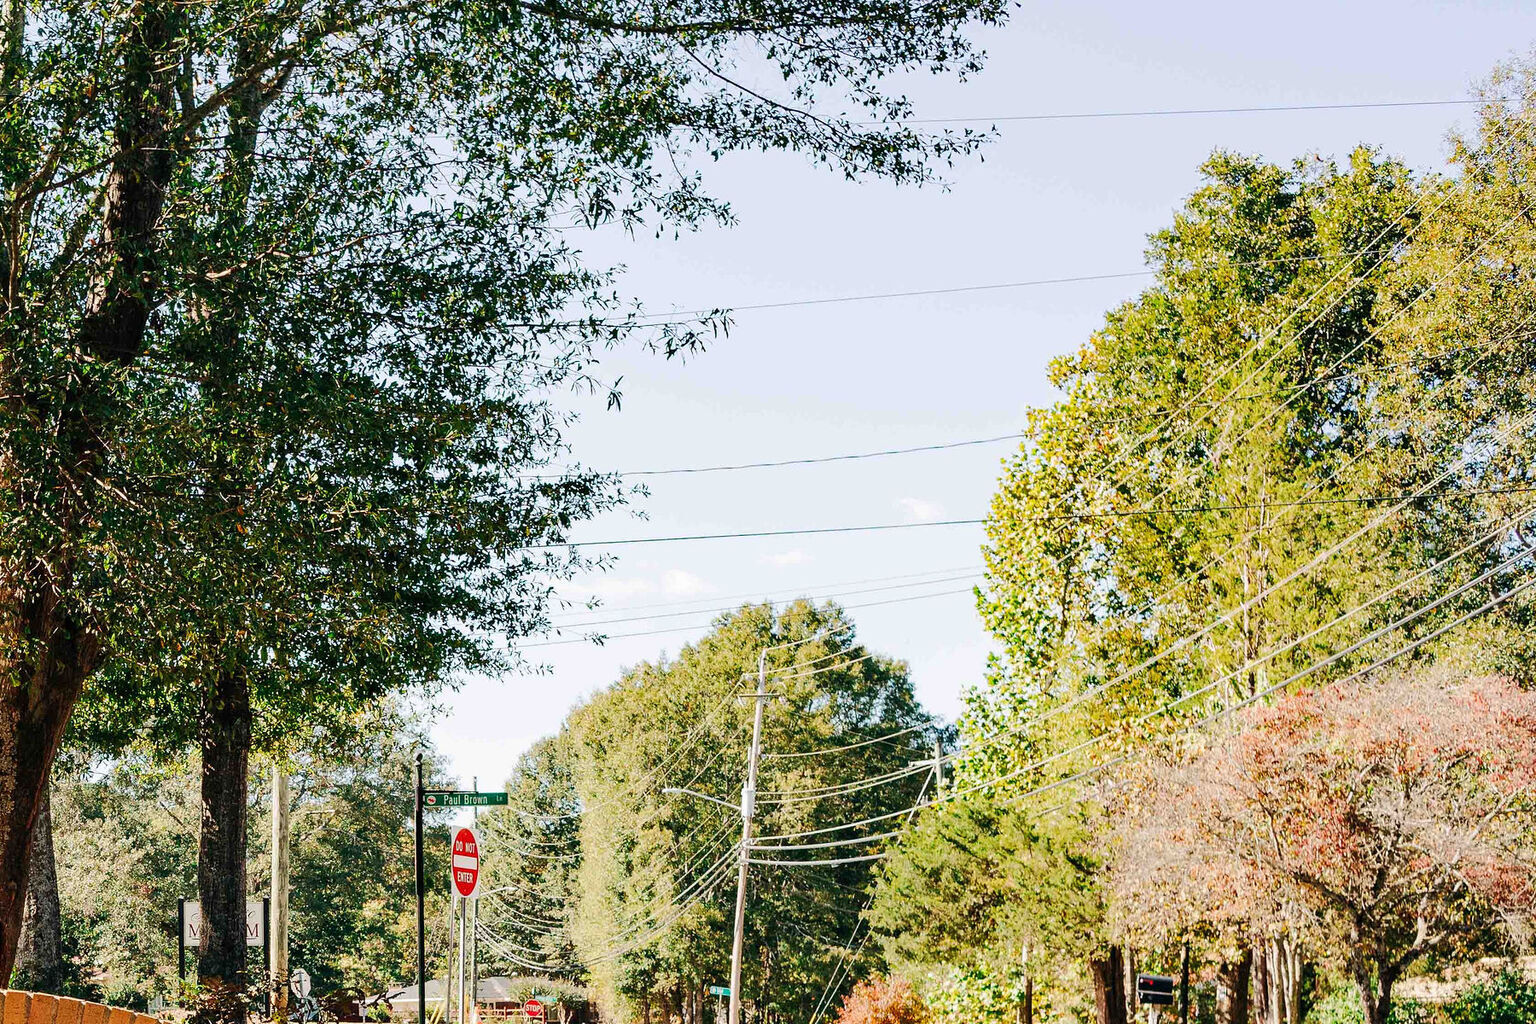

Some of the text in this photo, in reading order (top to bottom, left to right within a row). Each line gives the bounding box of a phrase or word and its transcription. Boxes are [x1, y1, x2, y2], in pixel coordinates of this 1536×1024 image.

[443, 794, 461, 805] Paul
[464, 794, 488, 805] Brown
[455, 840, 475, 854] DO NOT
[457, 871, 473, 884] ENTER
[526, 1004, 540, 1012] STOP
